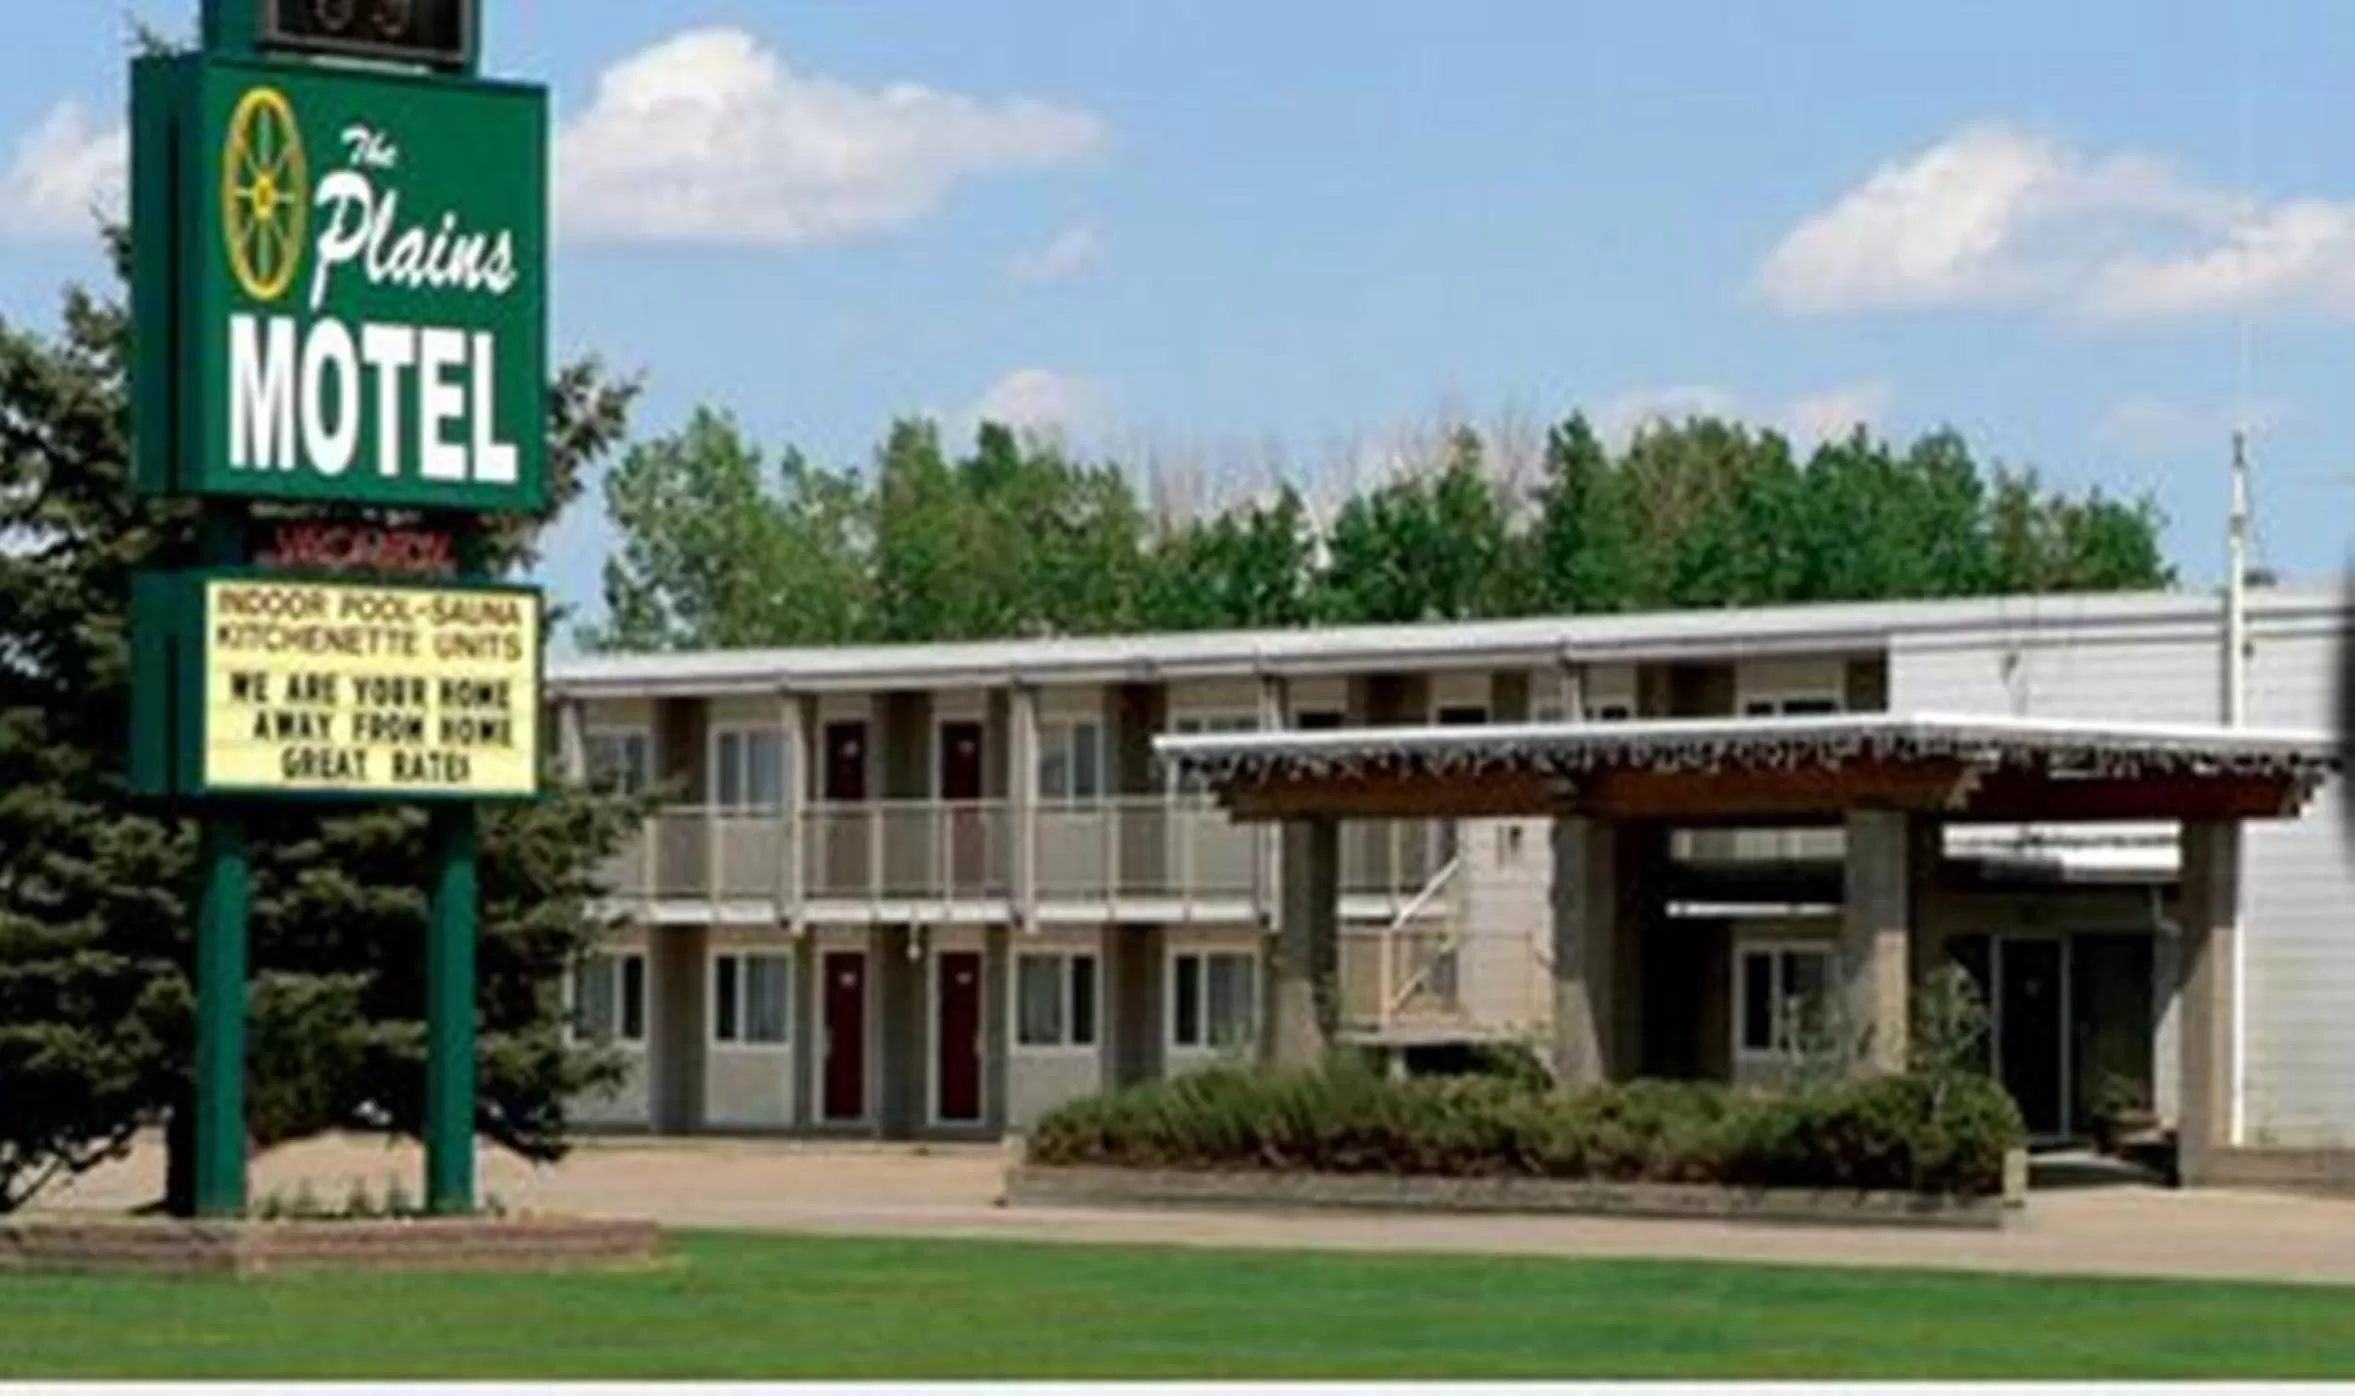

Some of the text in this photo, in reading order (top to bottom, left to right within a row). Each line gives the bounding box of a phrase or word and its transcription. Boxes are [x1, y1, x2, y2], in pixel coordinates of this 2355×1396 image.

[341, 125, 397, 168] The
[309, 170, 516, 311] Plains
[228, 314, 518, 482] MOTEL
[218, 588, 327, 620] INDOOR
[218, 623, 522, 661] KITCHENETTE UNITS
[230, 672, 511, 709] WE ARE YOUR HOME
[252, 711, 513, 748] AWAY FROM HOME
[280, 747, 366, 780] GREAT
